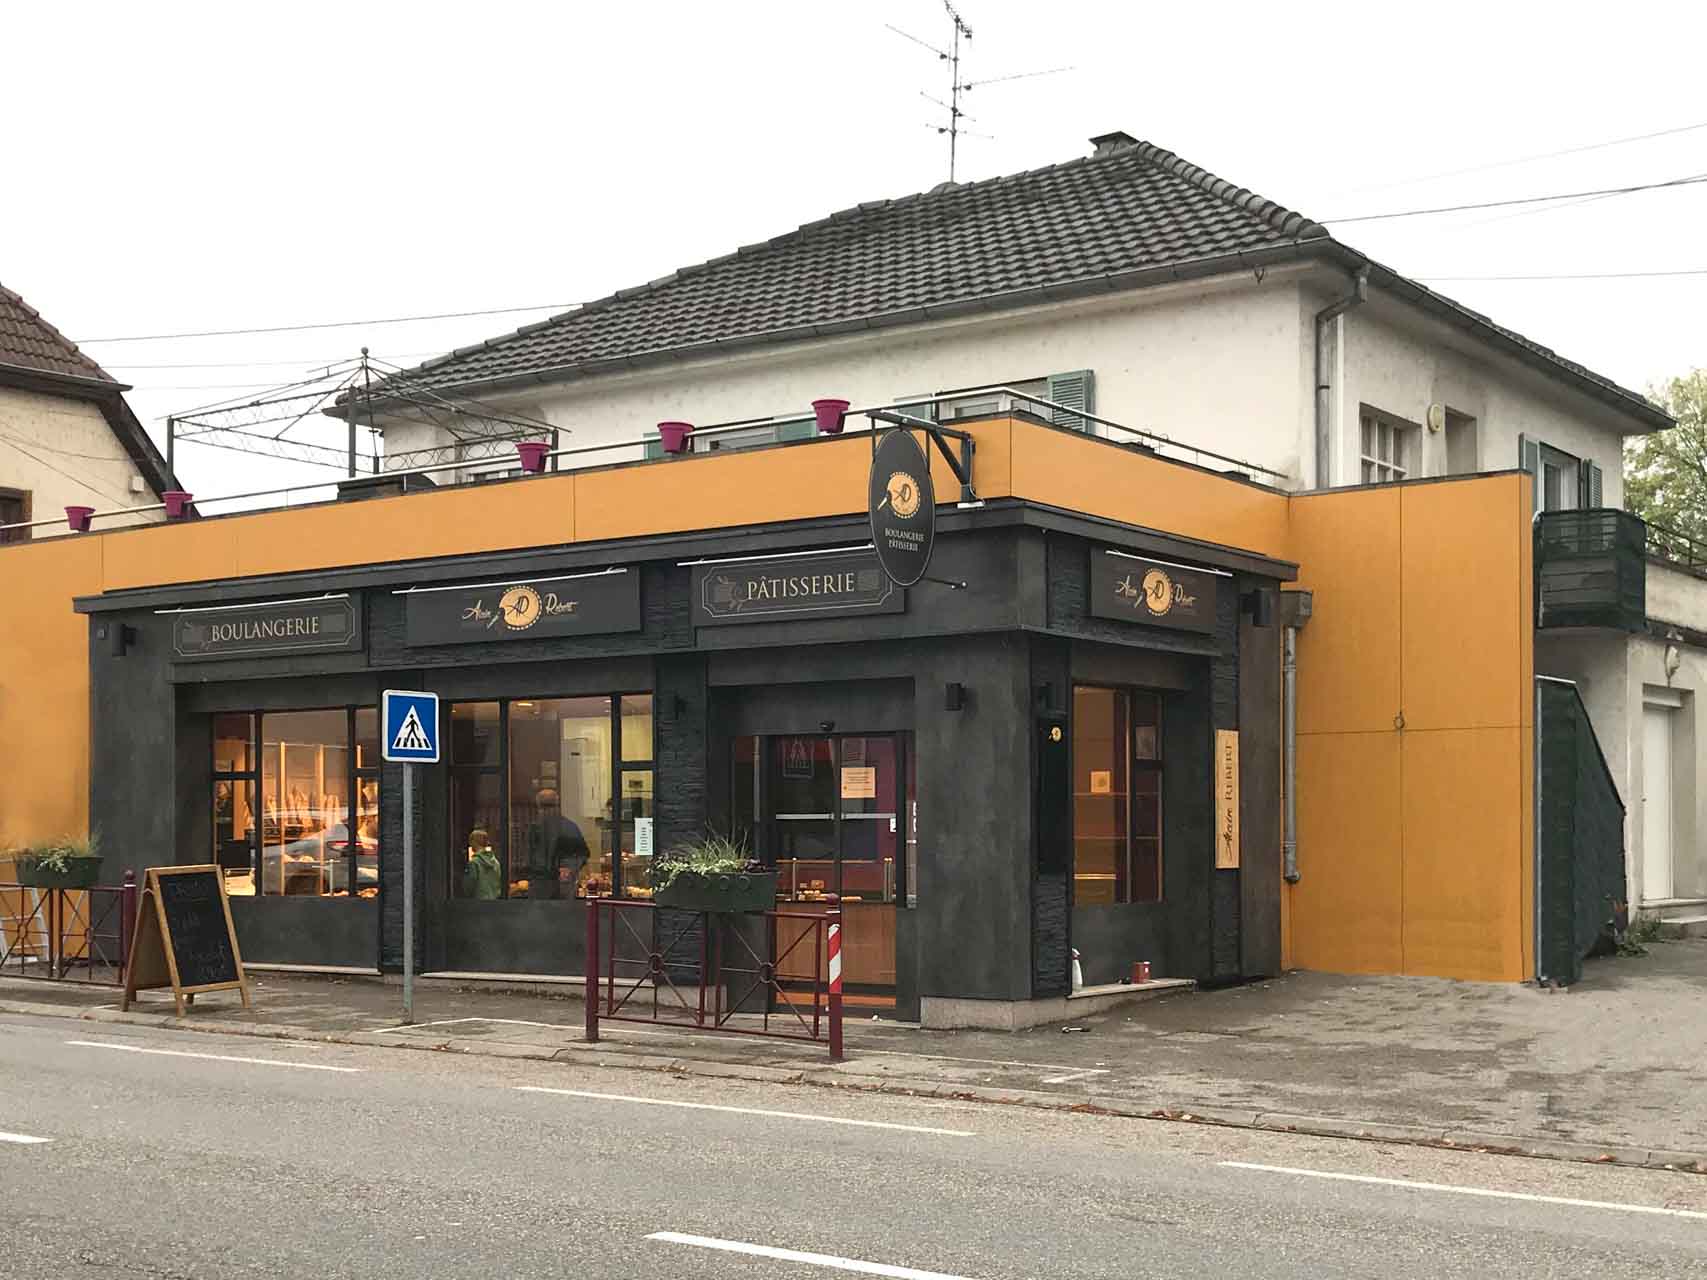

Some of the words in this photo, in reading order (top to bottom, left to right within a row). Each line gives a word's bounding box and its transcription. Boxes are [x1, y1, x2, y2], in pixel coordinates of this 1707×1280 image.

[884, 527, 925, 542] BOULANGERIE
[747, 573, 856, 600] PÂTISSERIE
[212, 616, 319, 641] BOULANGERIE
